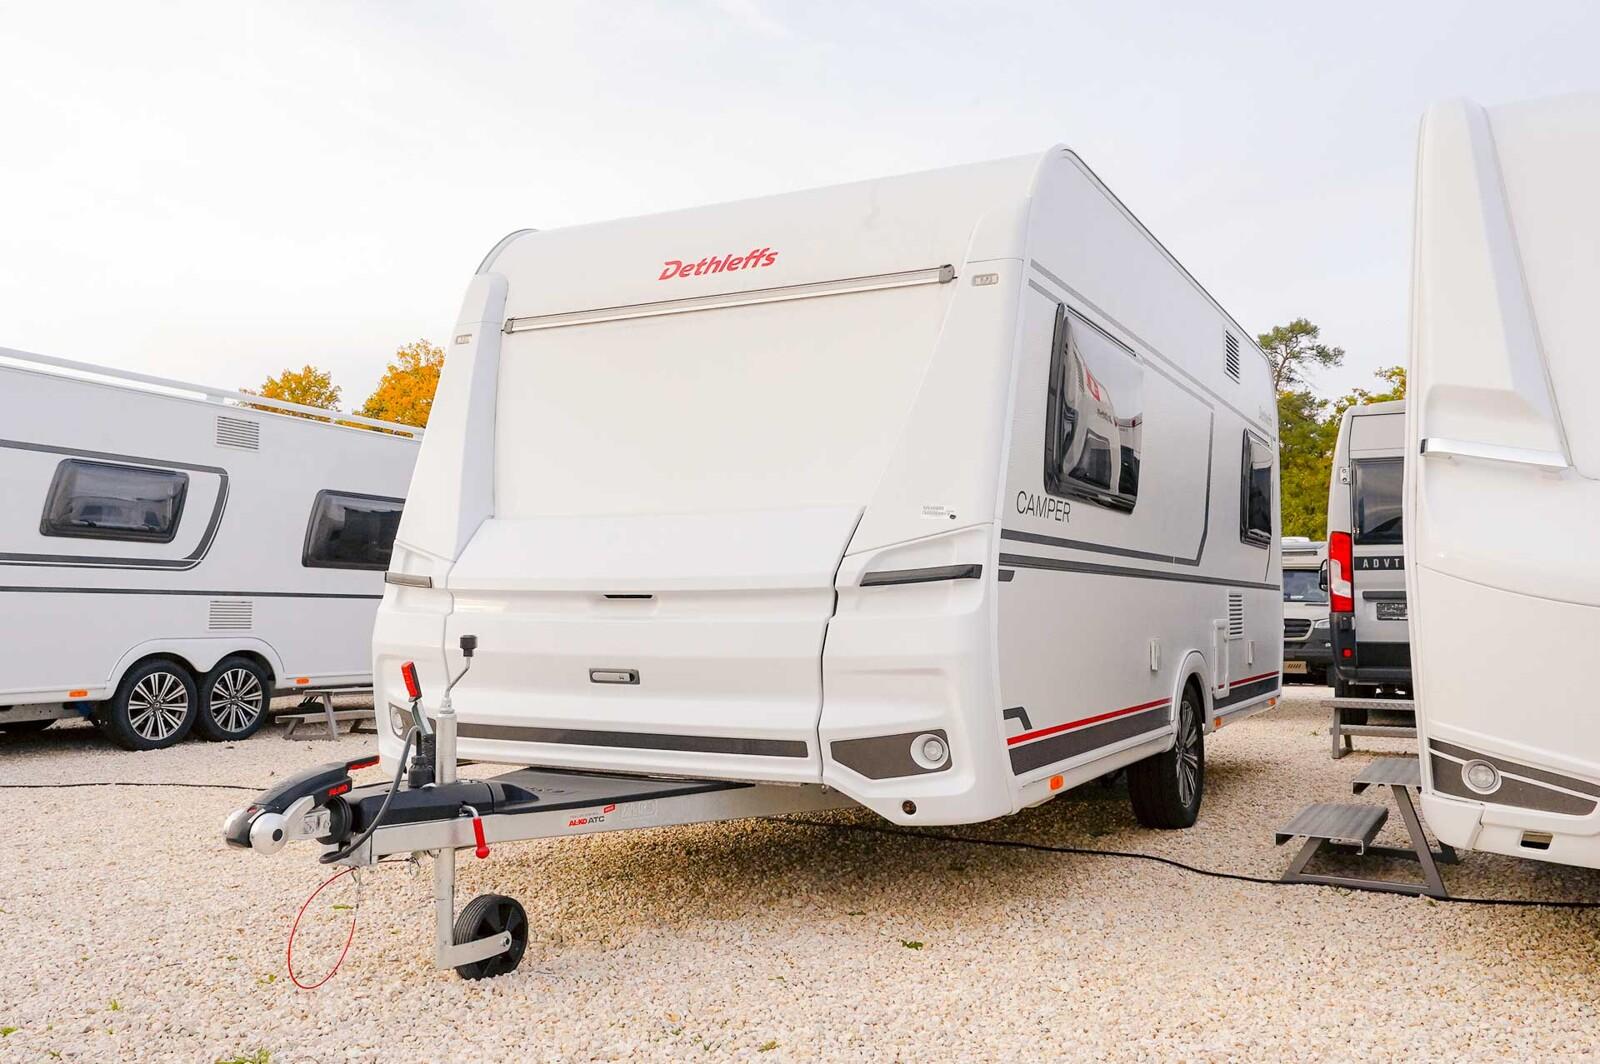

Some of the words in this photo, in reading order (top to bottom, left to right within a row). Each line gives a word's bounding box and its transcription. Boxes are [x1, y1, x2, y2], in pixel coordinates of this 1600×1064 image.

[658, 247, 778, 281] Dethleffs
[1016, 490, 1071, 523] CAMPER
[588, 815, 605, 825] ATC
